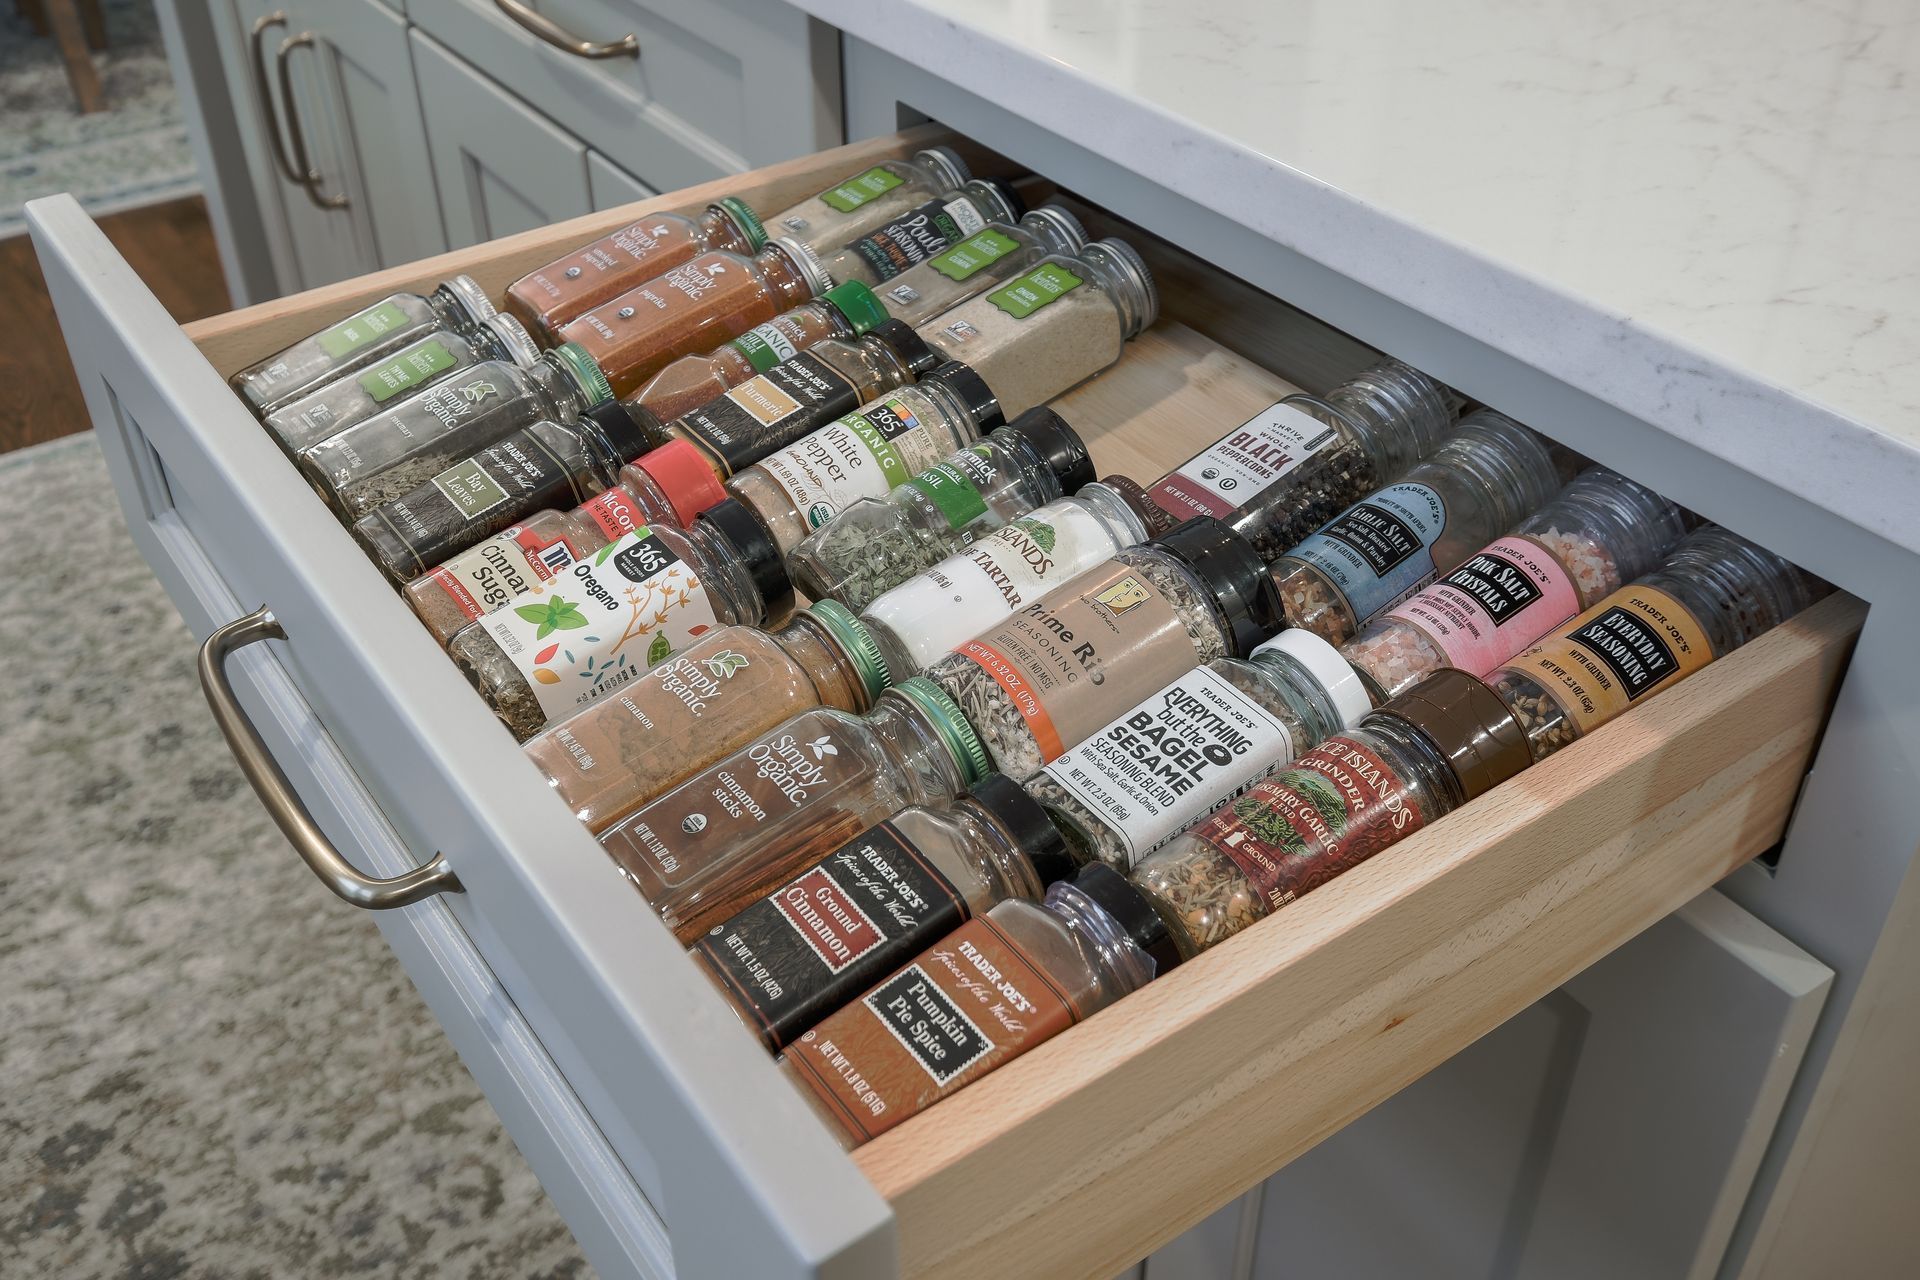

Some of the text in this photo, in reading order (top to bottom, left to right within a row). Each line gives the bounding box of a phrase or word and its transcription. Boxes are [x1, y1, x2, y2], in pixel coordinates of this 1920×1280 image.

[883, 225, 924, 262] SEASONIN
[681, 264, 717, 290] Simply
[1016, 287, 1039, 302] ONION
[638, 290, 667, 309] paprika
[756, 325, 792, 358] GANIC
[787, 360, 830, 390] TRADER JOE'S
[436, 385, 472, 417] Simply
[740, 382, 785, 418] Turmeric
[871, 409, 901, 432] 365
[917, 428, 932, 449] PURE
[1272, 422, 1304, 442] THRIVE
[502, 442, 541, 478] TRADER JOE'S
[800, 436, 847, 483] Pepper
[823, 427, 862, 469] White
[1227, 432, 1293, 472] BLACK
[1259, 431, 1291, 451] WHOLE
[465, 472, 487, 493] Bay
[1217, 446, 1274, 480] PEPPERCORNS
[445, 476, 476, 507] Leaves
[778, 467, 810, 505] 1.69 OZ (48g)
[1164, 486, 1177, 494] NET
[1392, 486, 1439, 520] TRADER JOE'S
[599, 509, 618, 534] TASTE
[600, 491, 636, 531] McCor
[1349, 507, 1411, 553] GARLIC SALT
[629, 543, 667, 572] 365
[1323, 540, 1363, 569] WITH GRINDER
[1367, 545, 1386, 567] Parsley
[1369, 532, 1391, 553] Roasted
[480, 545, 529, 596] Cinna
[525, 550, 549, 580] McCorm
[973, 552, 1022, 610] TARTAR
[1464, 556, 1530, 601] PINK SALT
[1491, 545, 1549, 583] TRADER JOE'S
[574, 564, 620, 611] Oregano
[1438, 590, 1454, 598] WITH
[1452, 596, 1476, 616] GRINDER
[1448, 570, 1508, 613] CRYSTALS
[1021, 603, 1105, 685] Prime Rib
[1603, 613, 1667, 671] EVERYDAY
[1628, 598, 1690, 654] TRADER JOE'S
[997, 635, 1053, 689] GLUTEN FREE NO MSG
[1013, 620, 1078, 682] SEASONING
[1568, 649, 1611, 691] WITH GRINDER
[1582, 625, 1648, 686] SEASONING
[654, 664, 706, 718] Organic.
[672, 658, 722, 699] Simply
[966, 643, 982, 655] NET
[978, 648, 992, 662] WT.
[991, 659, 1009, 677] 6.32
[1016, 690, 1040, 717] (179g)
[1538, 659, 1596, 713] NET WT. 2.3 OZ (65g)
[619, 696, 654, 730] cinnamon
[1156, 707, 1206, 747] but the
[1163, 686, 1253, 755] EVERYTHING
[1200, 687, 1256, 729] TRADER JOE'S
[771, 734, 828, 787] Simply
[1107, 726, 1194, 796] SESAME
[1125, 711, 1209, 783] BAGEL
[748, 744, 807, 808] Organic.
[1080, 747, 1098, 762] With
[1094, 758, 1106, 771] Sea
[1104, 767, 1120, 783] Salt,
[1117, 778, 1136, 795] Garlic
[1139, 796, 1159, 816] Onion
[1091, 738, 1175, 808] SEASONING BLEND
[1298, 758, 1366, 812] GRINDER
[1341, 750, 1413, 830] ISLANDS
[712, 787, 744, 819] sticks
[718, 771, 767, 822] cinnamon
[1069, 768, 1131, 821] NET WT. 2.3 OZ (65g)
[1268, 796, 1296, 819] BLEND
[632, 822, 649, 835] NET
[639, 829, 656, 842] WT.
[645, 837, 665, 852] 1.13
[1212, 817, 1230, 834] FRESH
[1298, 808, 1339, 856] GARLIC
[860, 845, 923, 909] TRADER JOE'S
[1242, 842, 1276, 872] GROUND
[785, 886, 851, 961] Cinnamon
[815, 887, 863, 934] Ground
[883, 899, 919, 928] World
[725, 934, 783, 1000] NET WT. 1.5 OZ (42G)
[957, 941, 1031, 1012] TRADER JOE'S
[887, 995, 948, 1061] Pie Spice
[907, 980, 969, 1047] Pumpkin
[988, 1002, 1027, 1033] World
[819, 1040, 887, 1116] NET WT. 1.8 OZ (51G)
